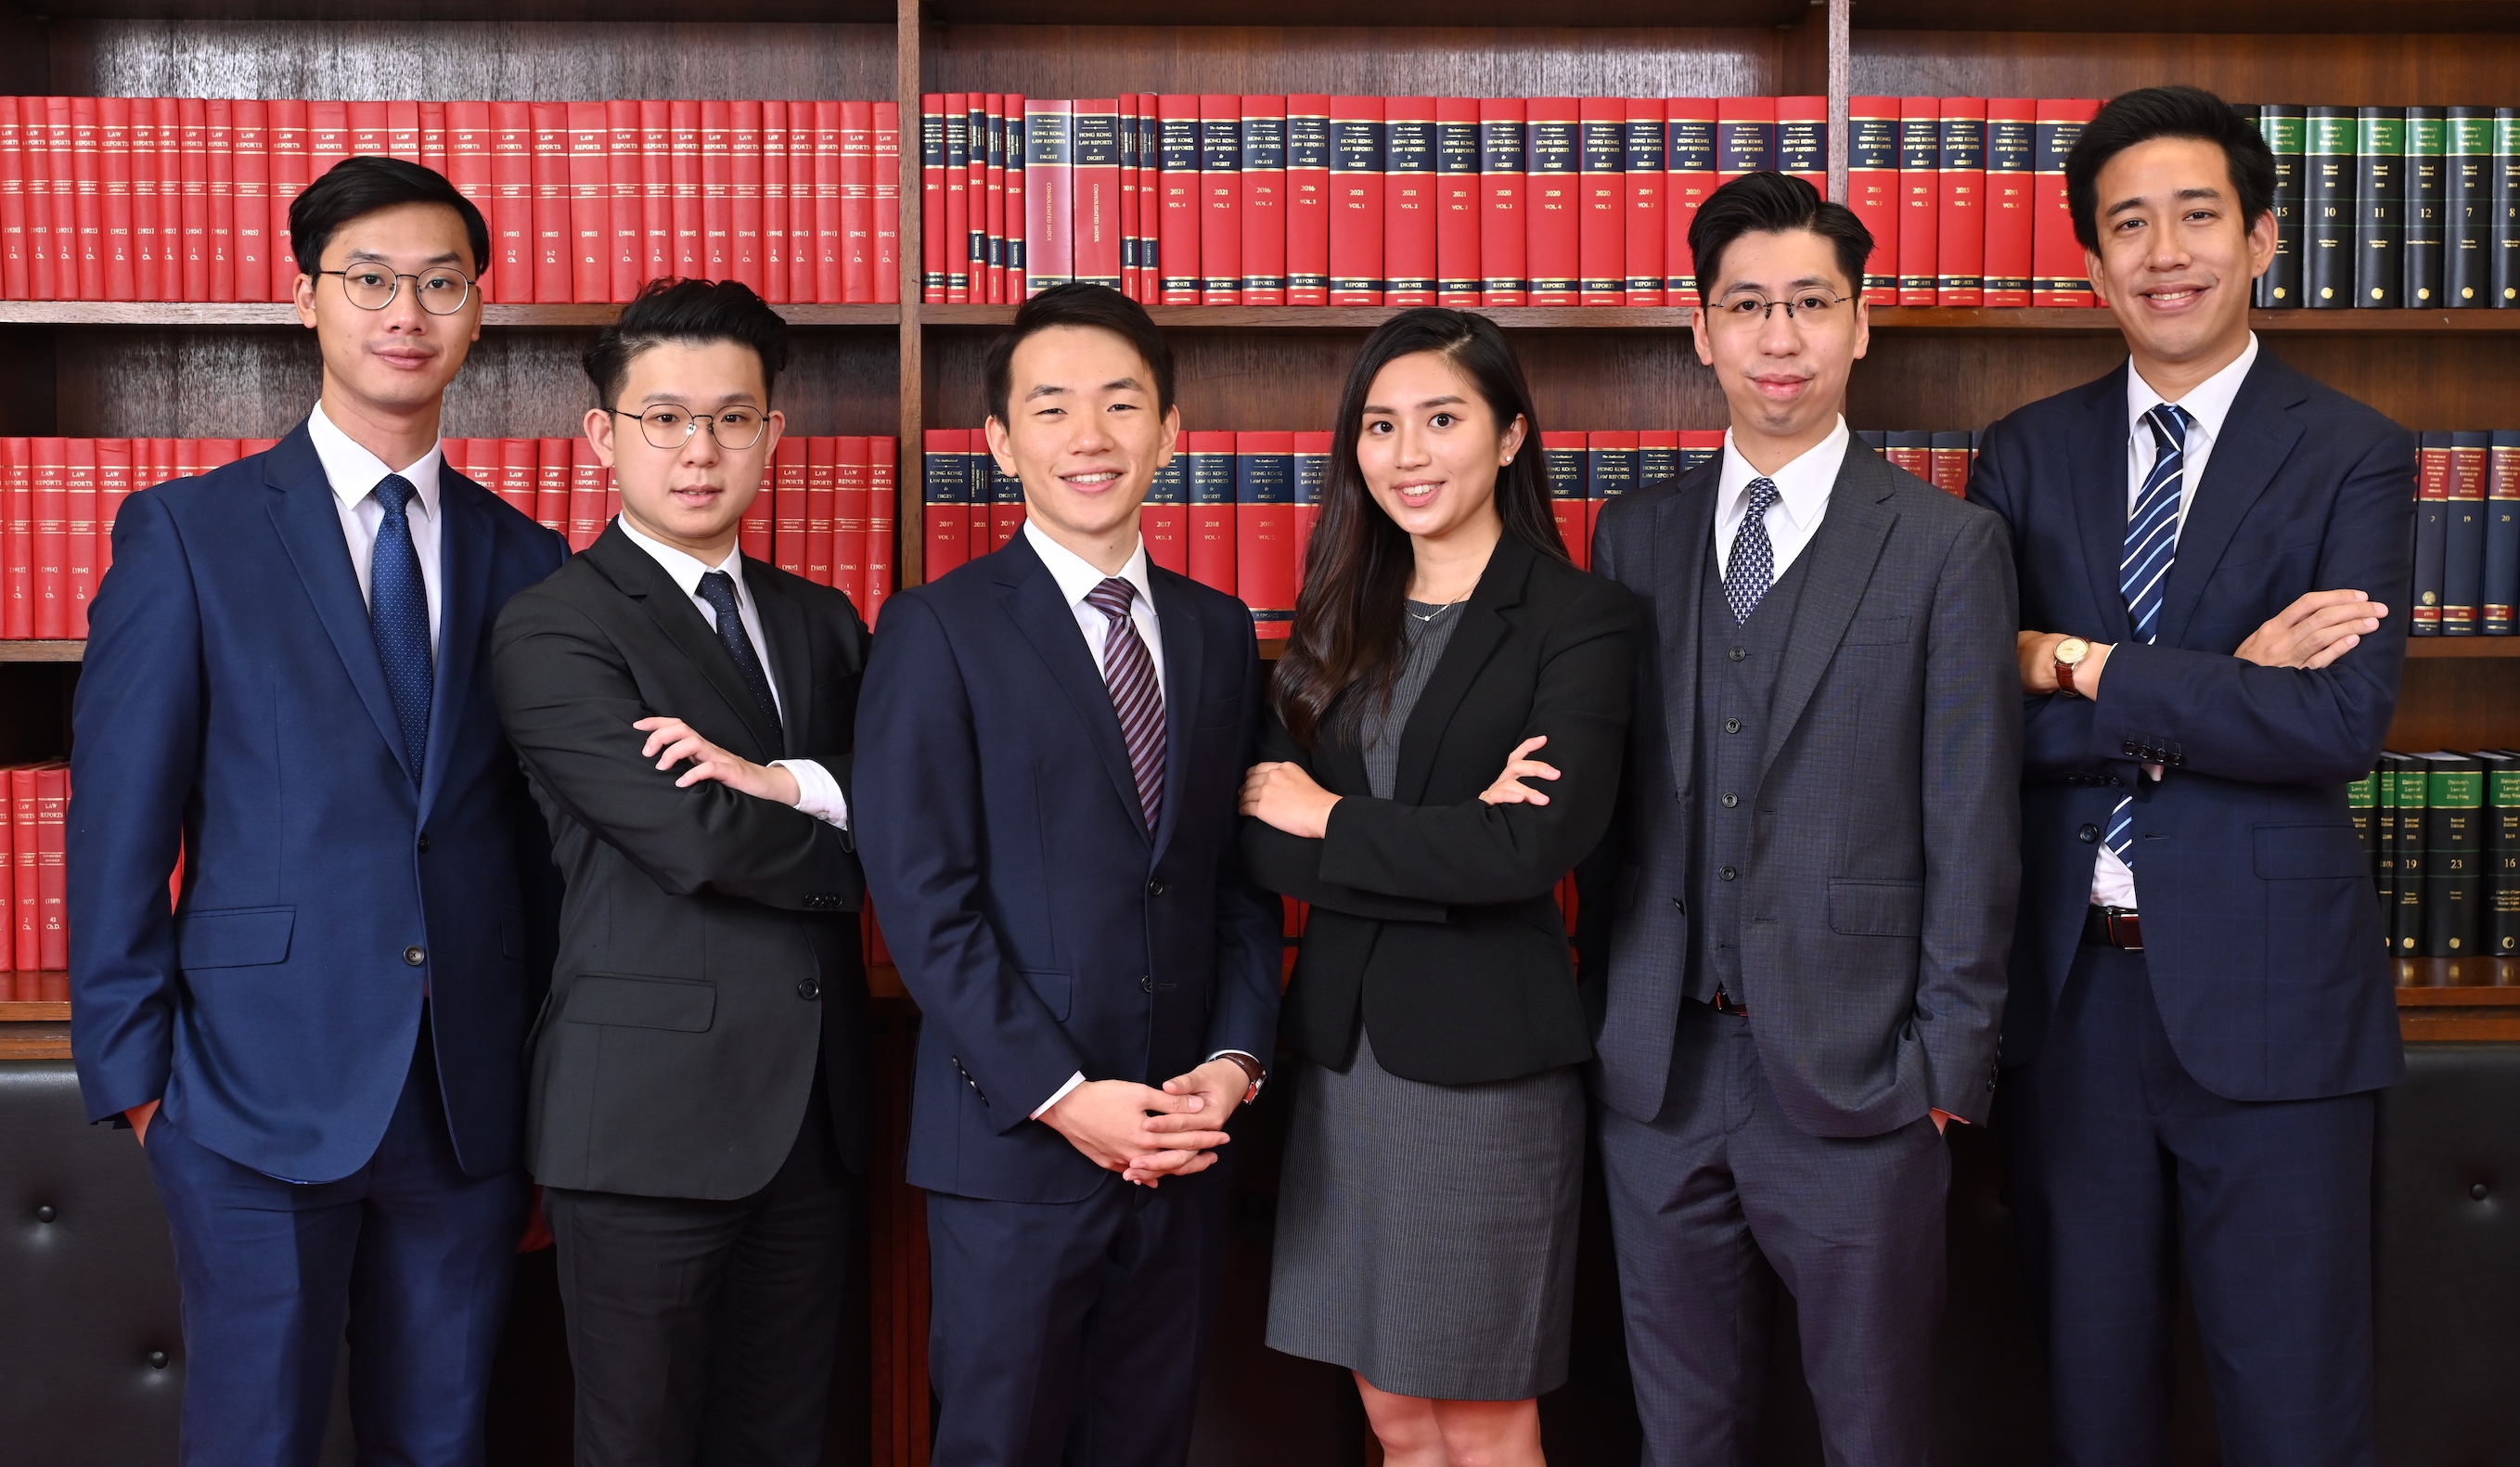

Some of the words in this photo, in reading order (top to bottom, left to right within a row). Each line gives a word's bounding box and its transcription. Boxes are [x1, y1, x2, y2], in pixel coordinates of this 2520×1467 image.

[2277, 207, 2287, 216] 15
[2324, 207, 2336, 217] 10
[2375, 208, 2384, 217] 11
[2421, 209, 2431, 217] 12
[2466, 208, 2472, 217] 7
[2510, 208, 2515, 217] 8
[2406, 859, 2417, 869] 19
[2451, 859, 2462, 869] 23
[2505, 858, 2515, 868] 16
